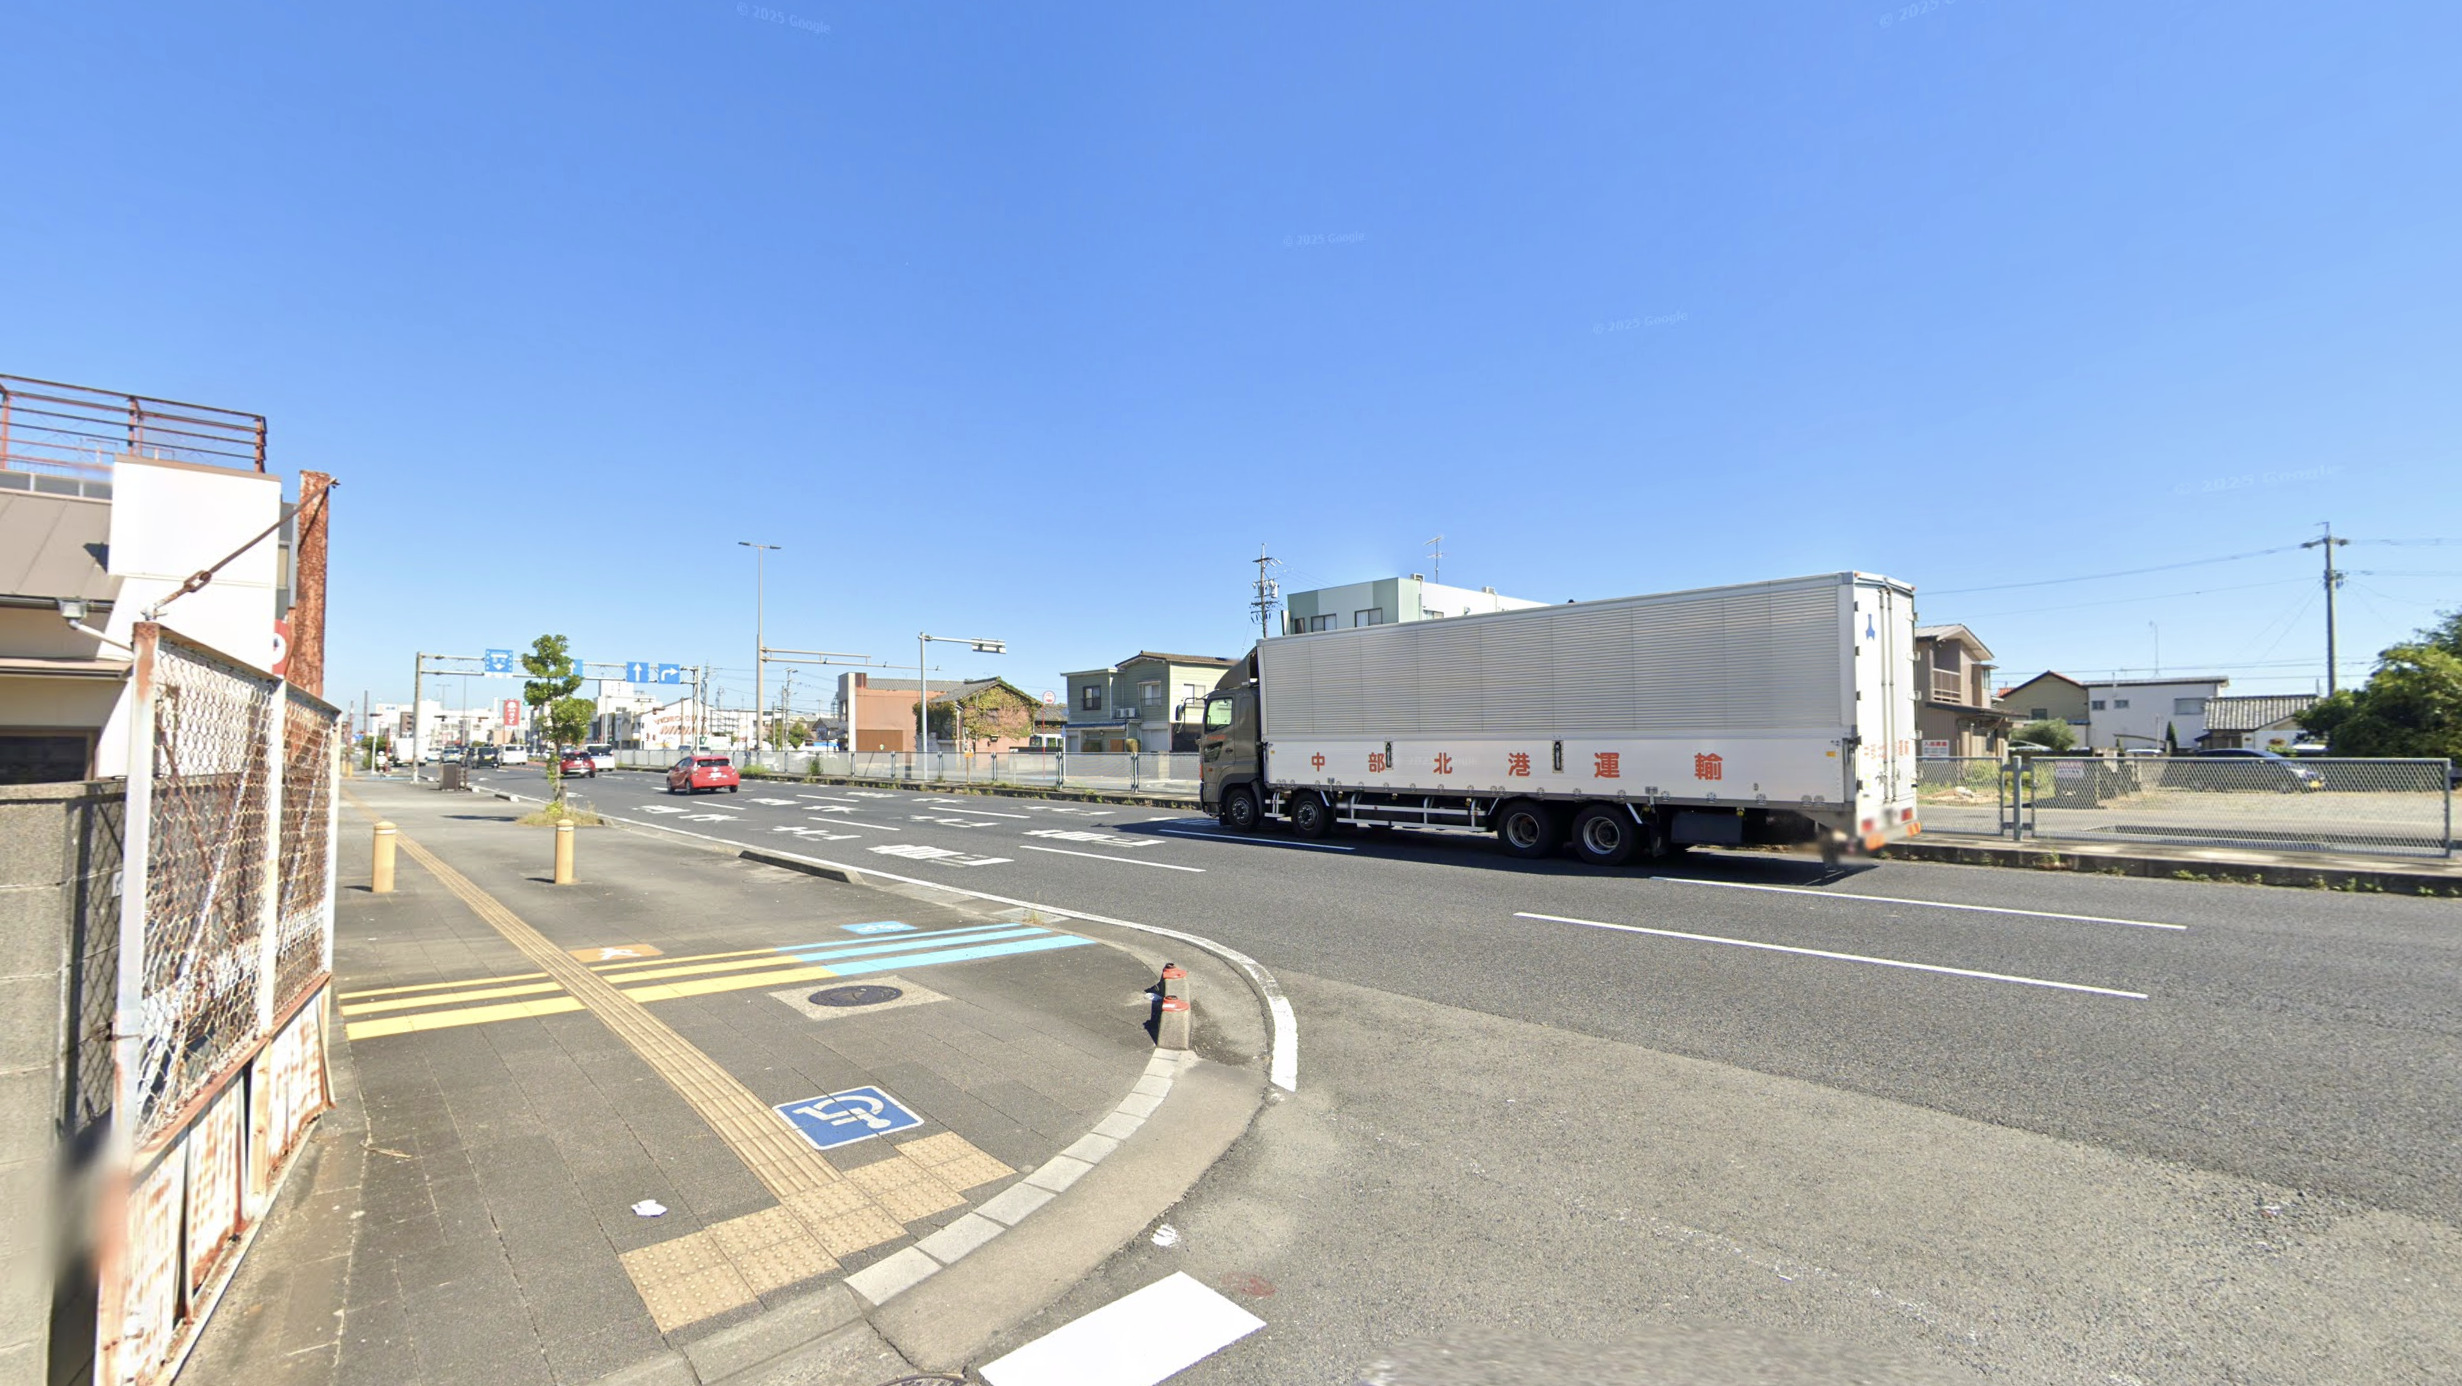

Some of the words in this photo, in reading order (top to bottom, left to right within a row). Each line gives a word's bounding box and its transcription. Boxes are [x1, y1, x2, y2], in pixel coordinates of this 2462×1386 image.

[1311, 751, 1723, 781] 中部北港運輸
